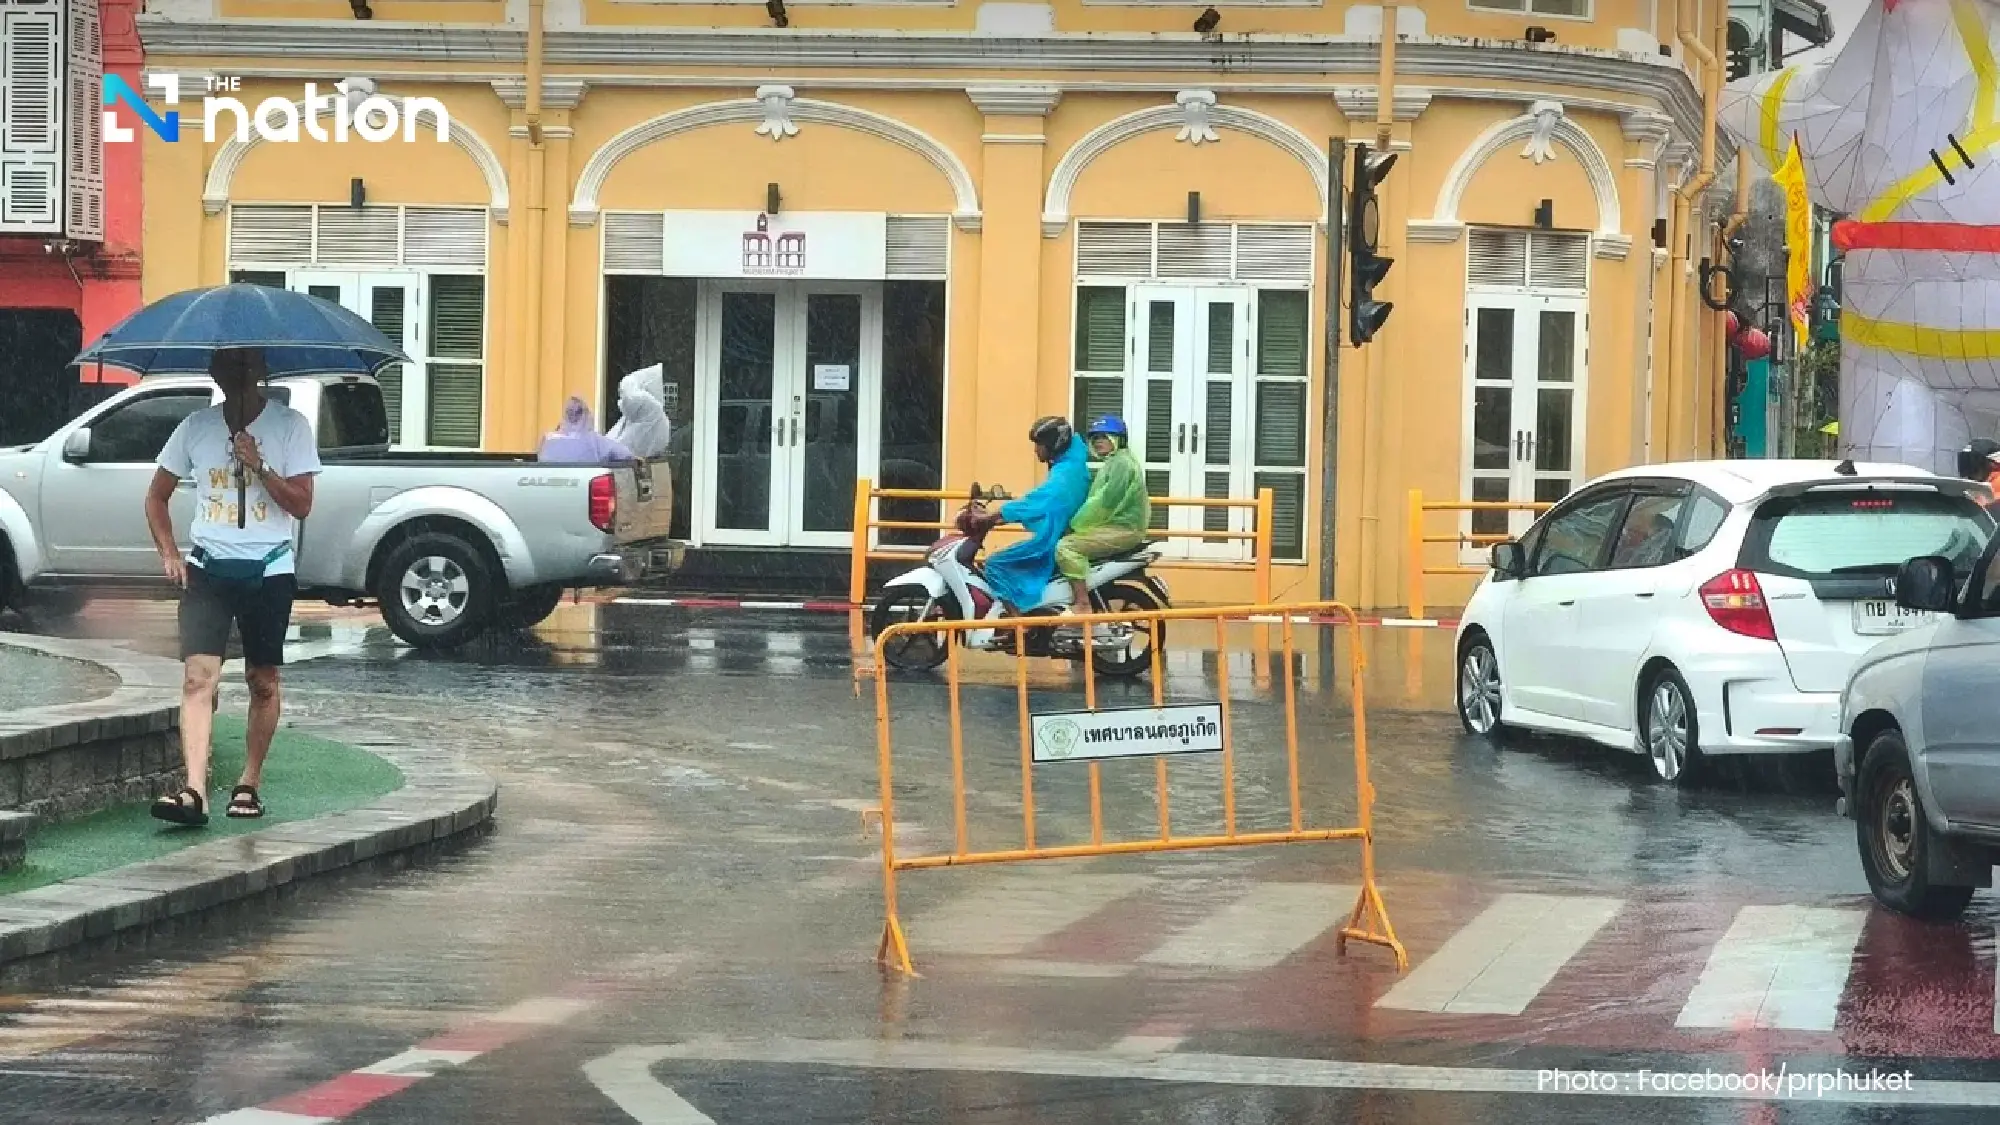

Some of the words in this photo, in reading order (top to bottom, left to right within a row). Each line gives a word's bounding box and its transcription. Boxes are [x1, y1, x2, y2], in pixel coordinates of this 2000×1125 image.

[1084, 716, 1217, 745] เทศบาลนครภูเก็ต
